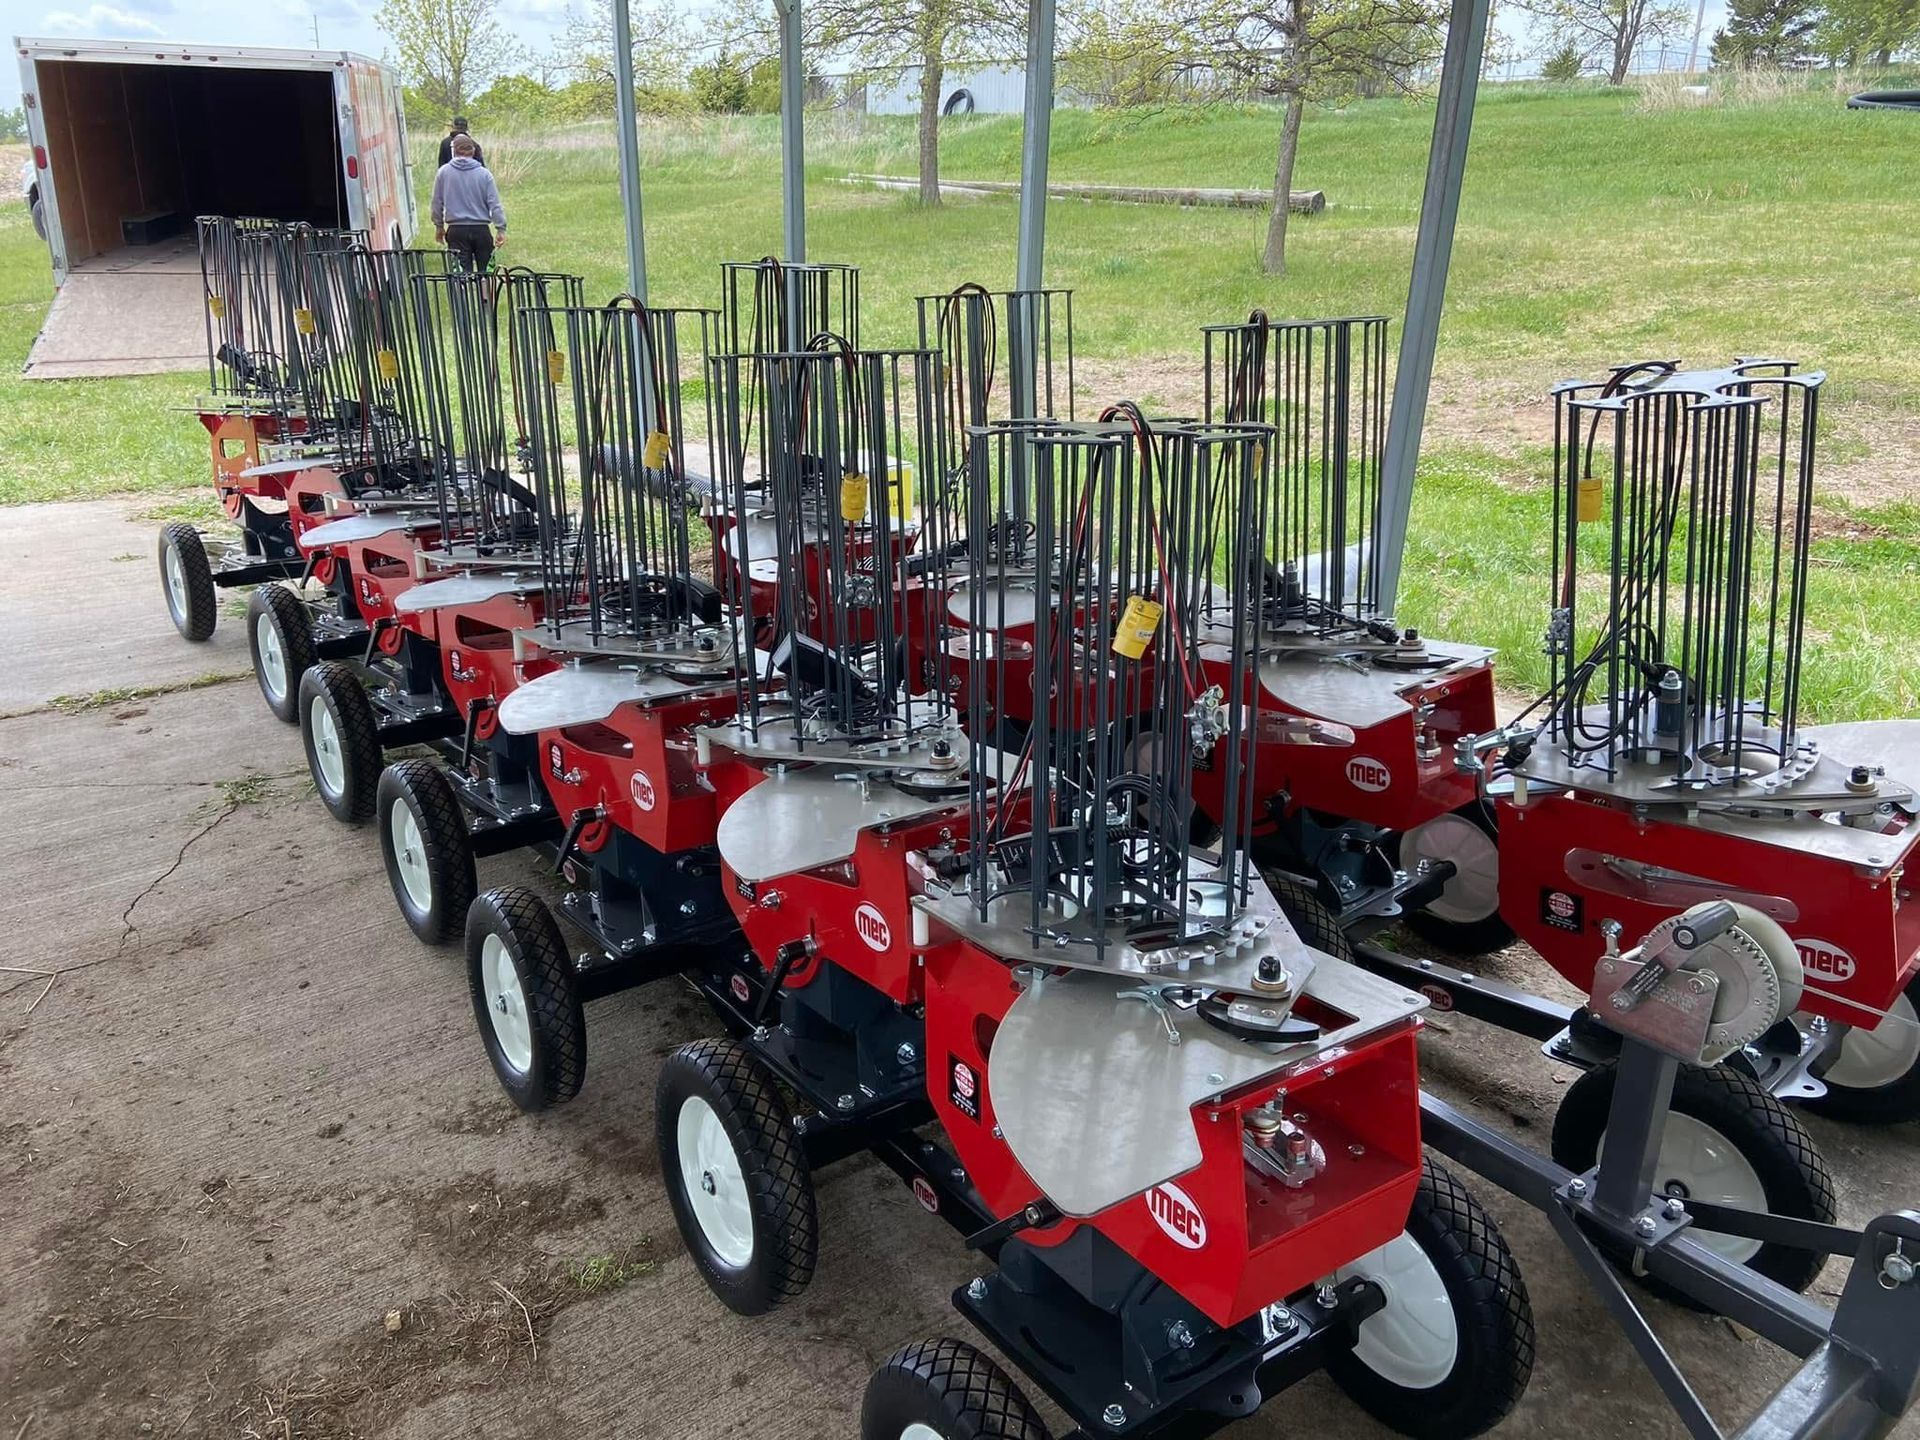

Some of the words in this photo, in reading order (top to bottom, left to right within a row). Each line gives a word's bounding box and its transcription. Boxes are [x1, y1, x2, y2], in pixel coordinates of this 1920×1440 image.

[1350, 763, 1387, 787] mec
[632, 779, 653, 806] mec
[858, 911, 887, 947] mec
[1794, 943, 1849, 977] mec
[915, 1181, 936, 1210] mec
[1152, 1187, 1200, 1245] mec
